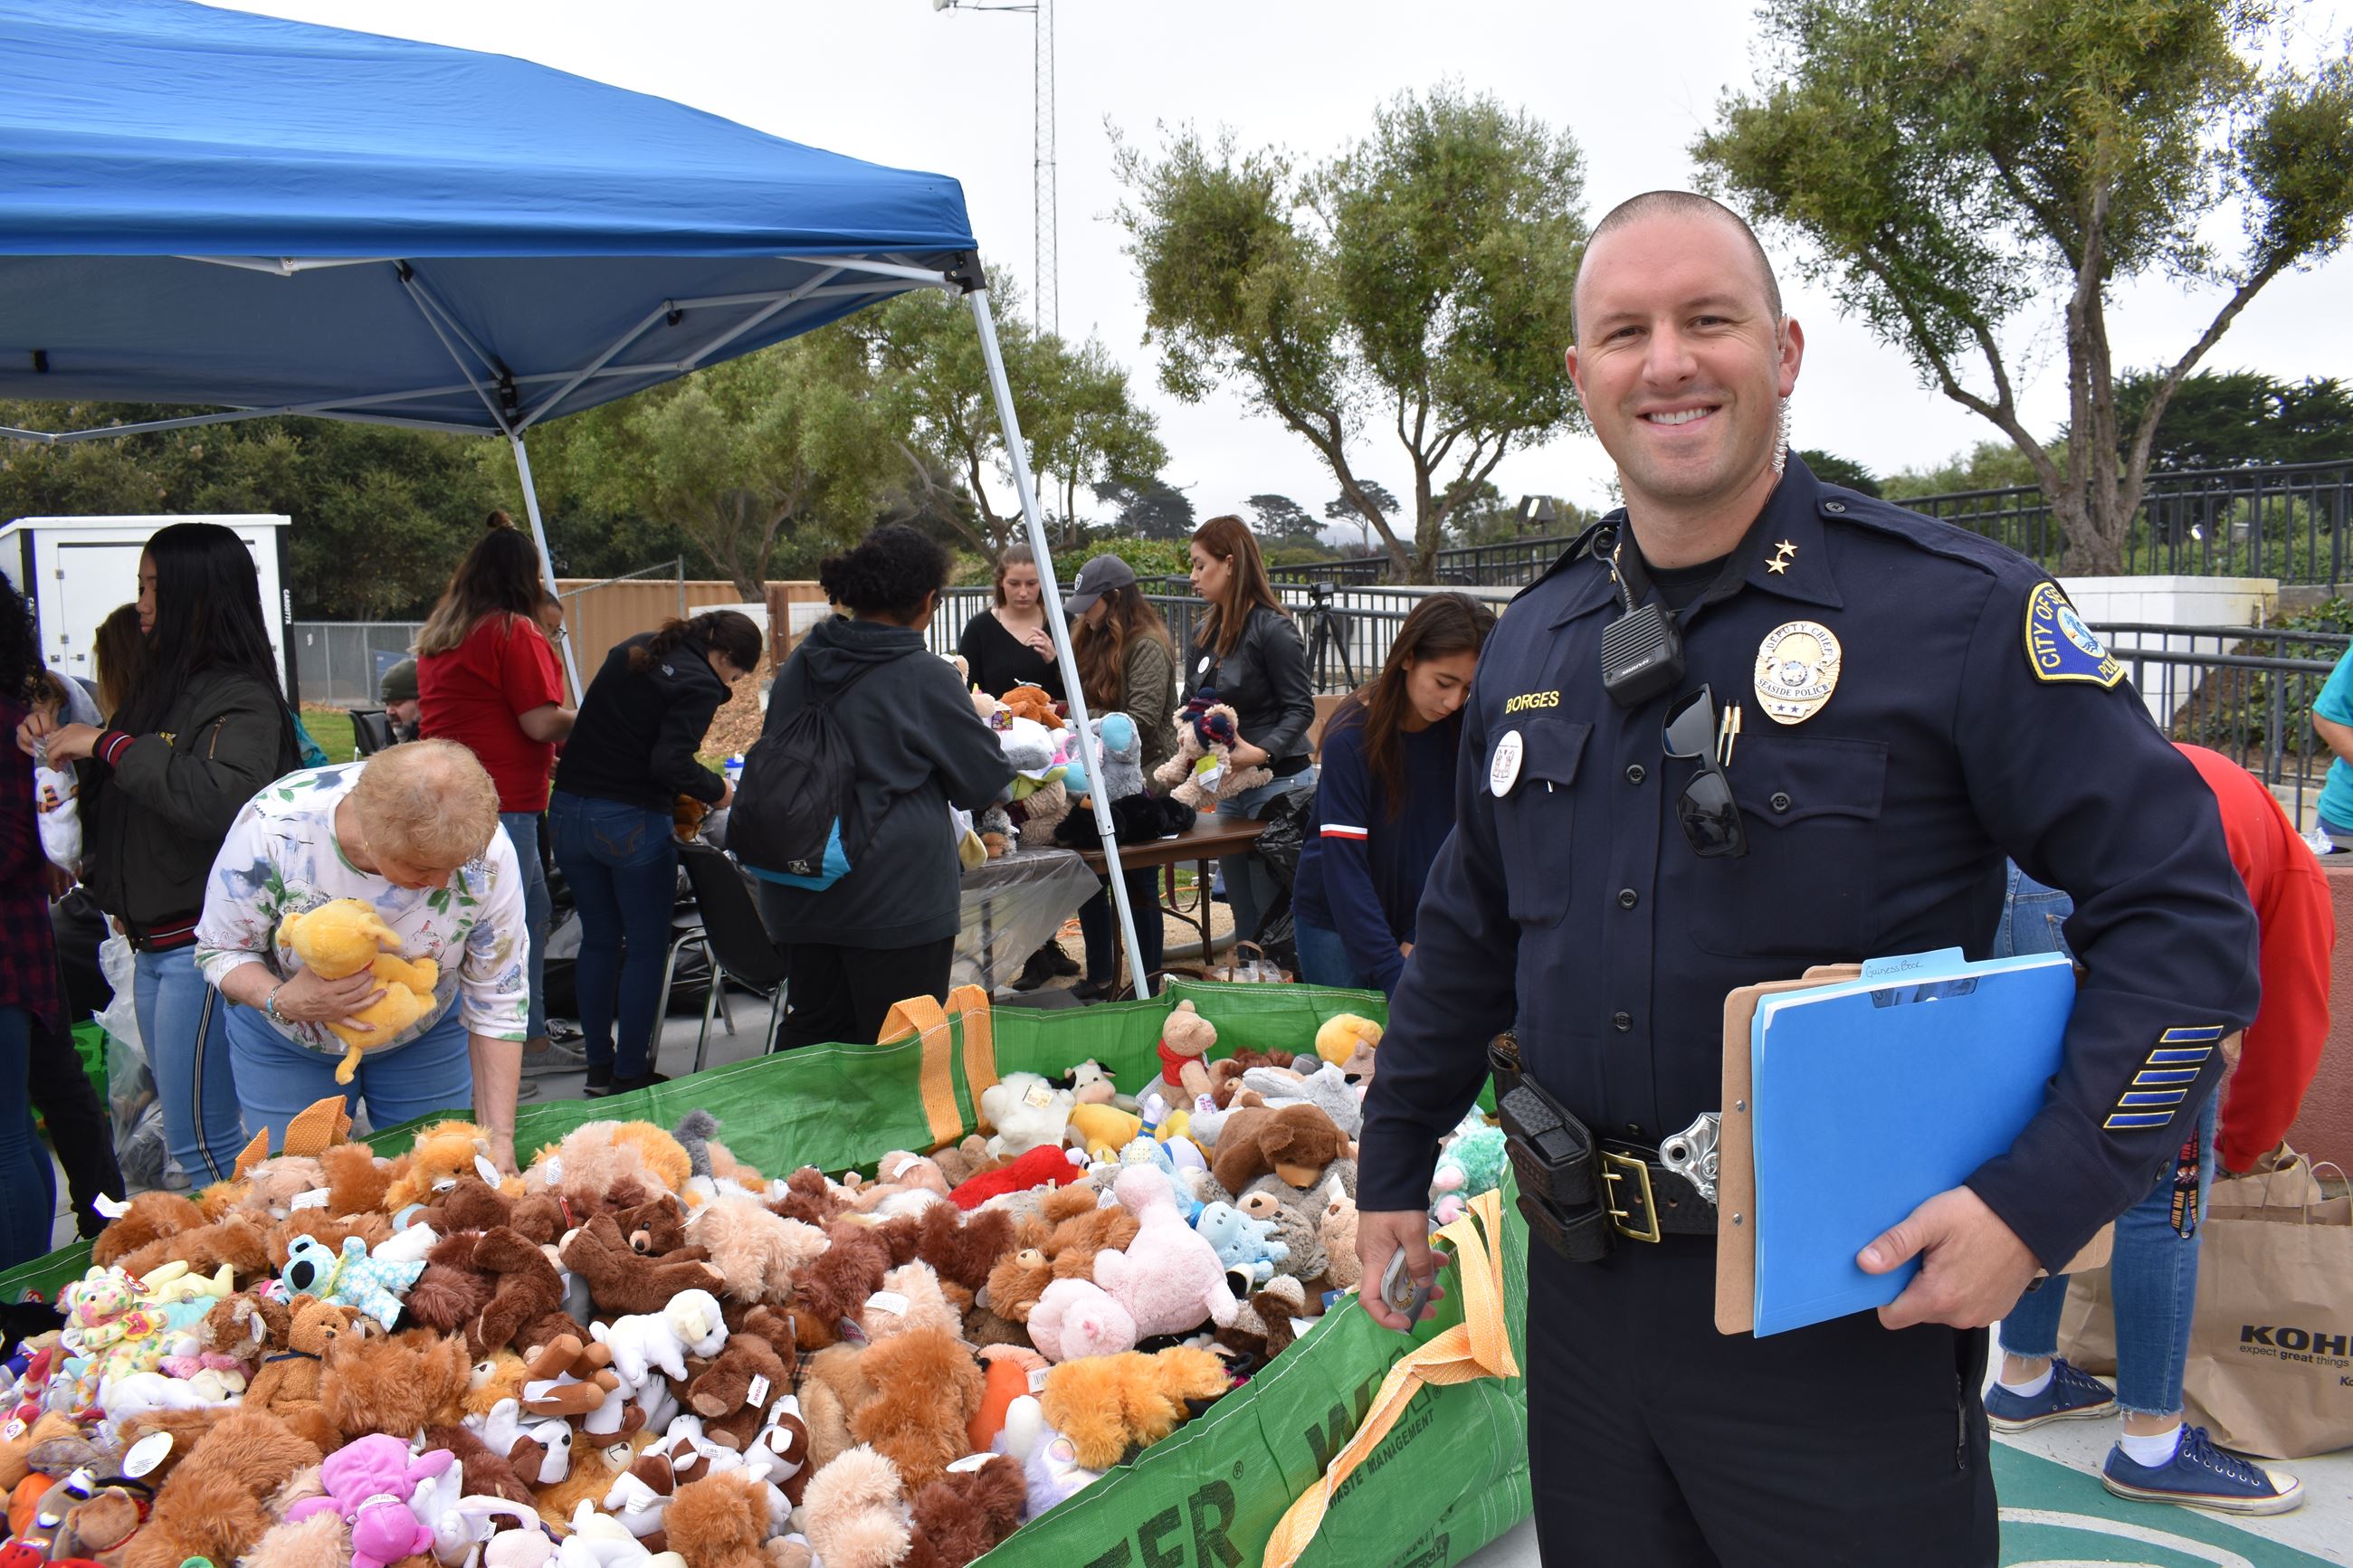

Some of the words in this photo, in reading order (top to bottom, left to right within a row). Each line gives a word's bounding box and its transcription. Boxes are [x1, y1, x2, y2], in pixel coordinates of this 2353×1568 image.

[2035, 595, 2053, 620] OF
[1766, 623, 1808, 650] DEPUTY
[1811, 627, 1834, 657] CHIEF
[2034, 622, 2062, 668] CITY
[1757, 678, 1792, 697] SEASIDE
[1795, 683, 1829, 698] POLICE
[1505, 690, 1560, 715] BORGES
[2173, 1190, 2186, 1209] MAN
[2240, 1325, 2353, 1356] KOH
[2240, 1345, 2277, 1356] expect
[2280, 1351, 2314, 1364] great
[2317, 1355, 2350, 1369] things
[1366, 1407, 1434, 1476] MANAGEMENT
